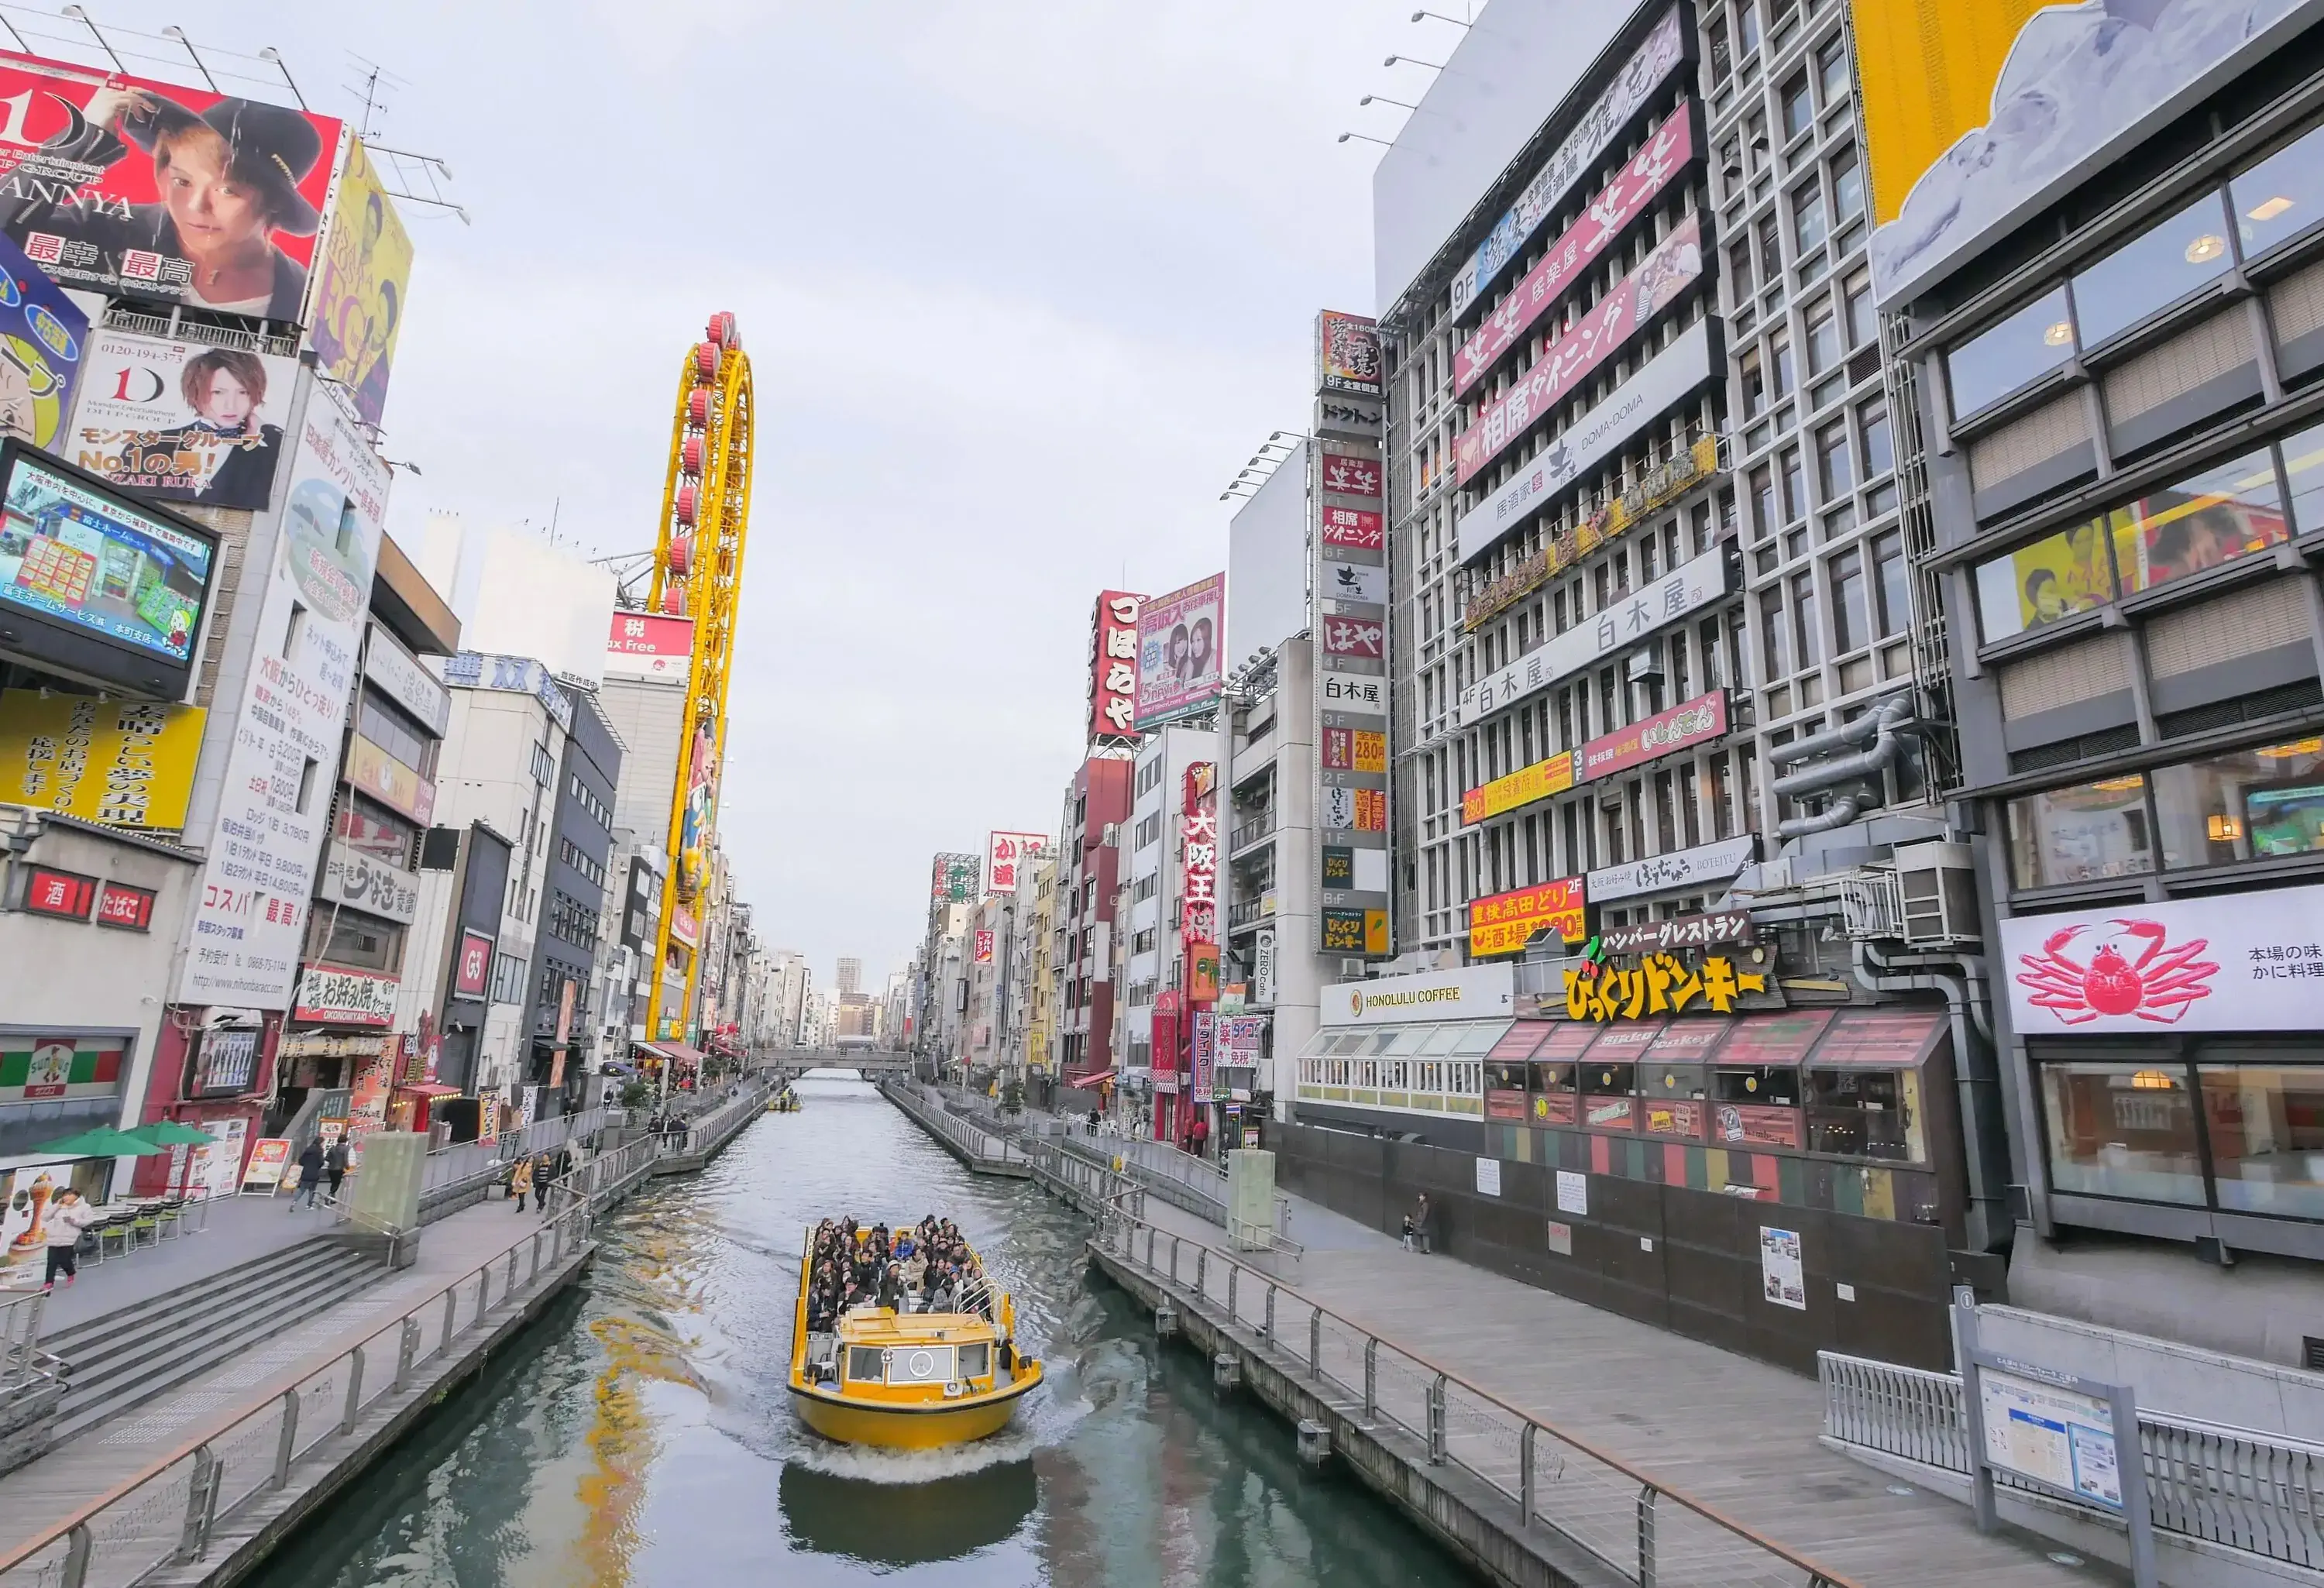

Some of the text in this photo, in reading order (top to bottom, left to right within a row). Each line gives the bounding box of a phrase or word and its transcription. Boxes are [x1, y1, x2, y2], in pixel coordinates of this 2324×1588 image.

[19, 163, 104, 186] GROUP
[1541, 155, 1579, 211] 居酒屋
[0, 172, 136, 222] ANNYA
[125, 252, 195, 285] 最高
[1531, 239, 1578, 306] 居楽屋
[101, 344, 183, 364] 0120-194-373
[1326, 375, 1342, 387] 9F
[1481, 292, 1627, 457] 相席ダイニング
[80, 428, 264, 451] モンスターグループ
[1497, 394, 1644, 521] 居酒家 DOMA-DOMA
[1332, 510, 1358, 526] 相席
[1324, 524, 1383, 546] ダイニング
[1336, 603, 1352, 614] 5F
[624, 619, 645, 638] 税
[607, 639, 656, 653] ax Free
[1462, 688, 1476, 706] 4F
[1480, 656, 1543, 713] 白木屋
[1597, 577, 1688, 652] 白木屋
[1325, 676, 1380, 703] 白木屋
[1356, 731, 1382, 742] 全品
[53, 699, 96, 807] あなたのお店づくり
[1356, 741, 1385, 759] 280円
[18, 736, 57, 796] 応援します
[98, 703, 169, 824] 素晴らしい夢の実現
[994, 864, 1015, 885] 道
[1590, 876, 1604, 889] 大阪
[1697, 852, 1737, 871] BOTEJYU
[45, 880, 67, 906] 酒
[99, 892, 139, 919] たばこ
[204, 885, 302, 926] コスパ 最高!
[1324, 892, 1346, 906] B1F
[1472, 878, 1582, 923] 豊後高田どり 2F
[1326, 917, 1360, 935] びっくり
[1487, 923, 1528, 950] 酒場
[1602, 915, 1745, 950] ハンバーグレストラン
[1325, 932, 1363, 949] ドンキー
[2248, 942, 2322, 962] 本場の味
[198, 947, 229, 966] 予約受付
[466, 950, 483, 980] G3
[1260, 949, 1270, 976] ZERO
[2252, 964, 2324, 981] かに料理
[322, 974, 375, 1010] お好み焼
[1367, 986, 1461, 1008] HONOLULU COFFEE
[1563, 953, 1765, 1023] びっくりドンキー
[323, 1010, 367, 1021] OKONOMIYAKI
[1219, 1023, 1231, 1047] 薬
[1230, 1050, 1250, 1065] 免税
